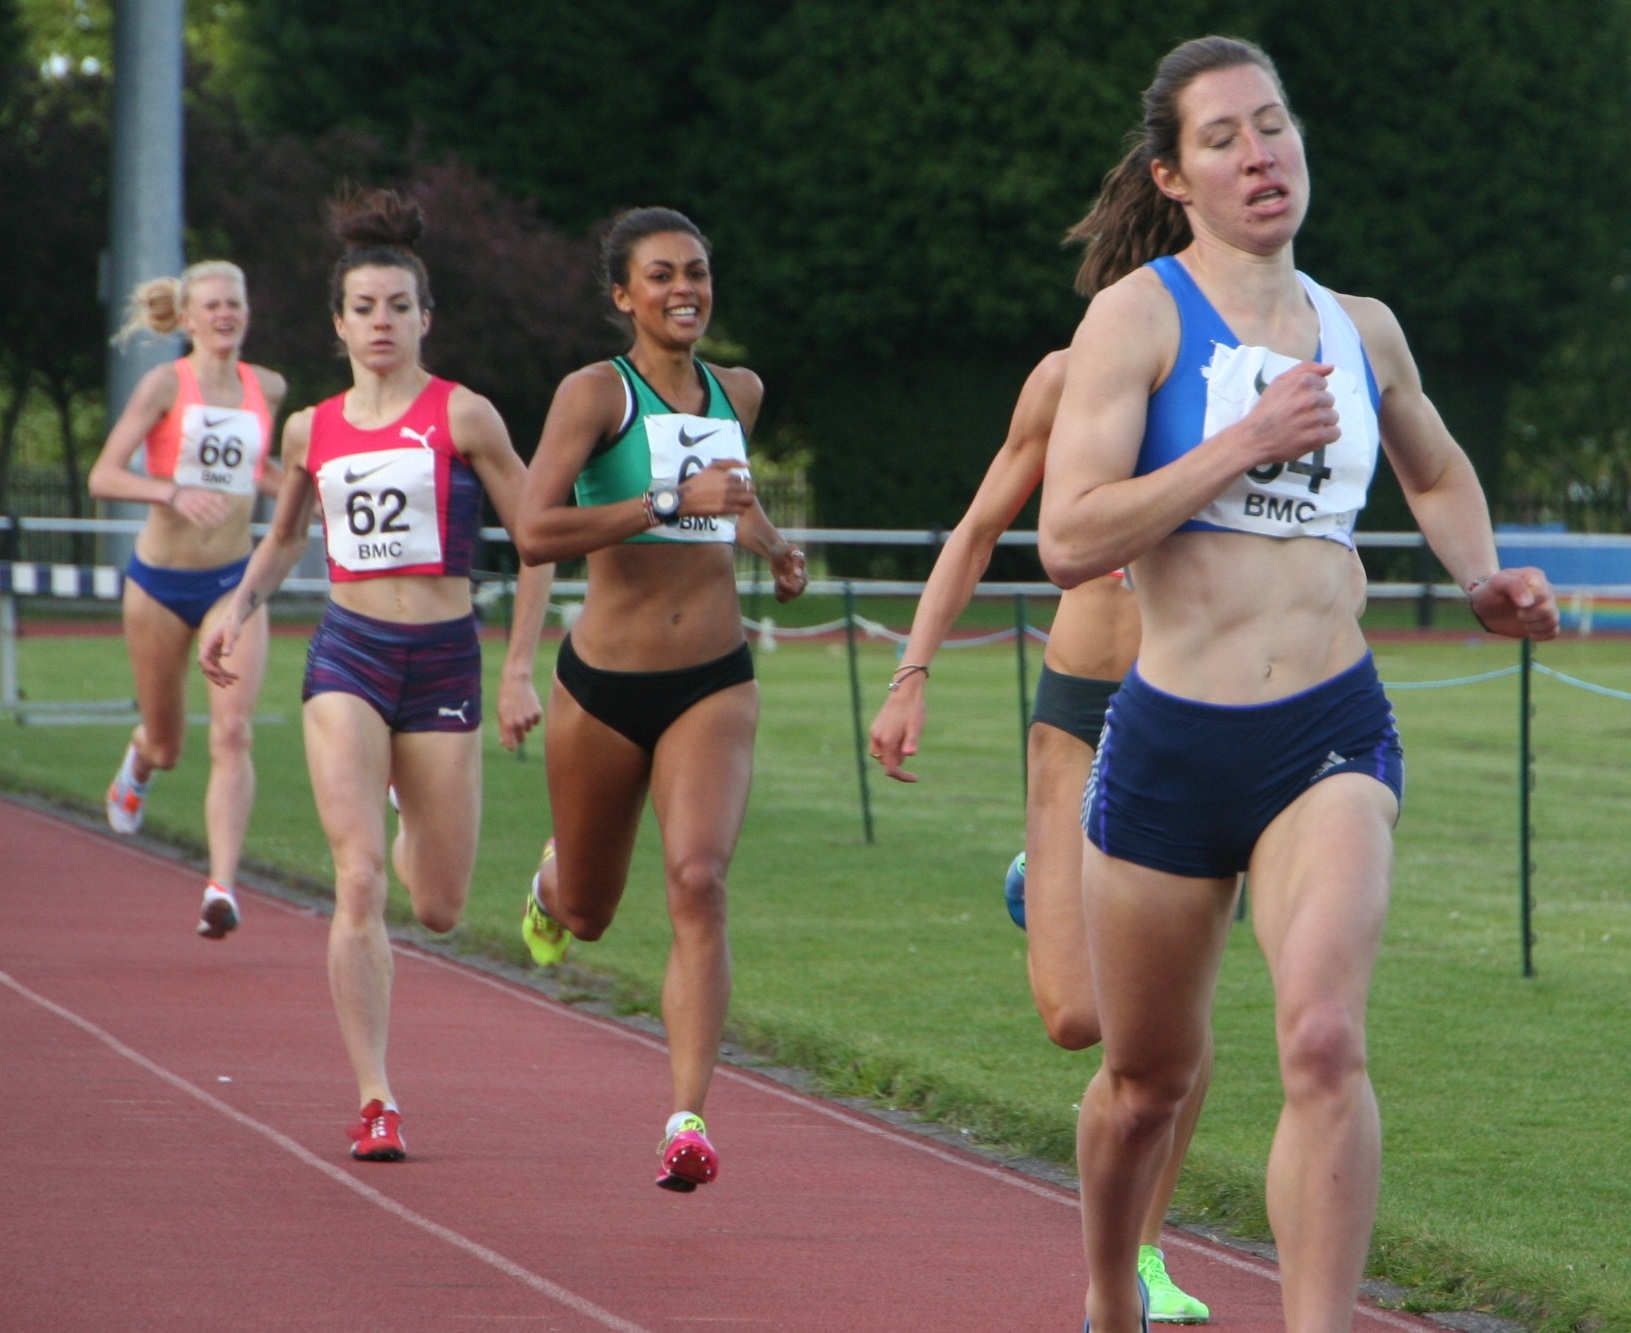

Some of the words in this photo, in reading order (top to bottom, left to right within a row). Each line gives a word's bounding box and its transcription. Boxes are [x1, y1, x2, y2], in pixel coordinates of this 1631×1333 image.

[199, 434, 243, 468] 66
[346, 488, 410, 536] 62
[1244, 493, 1317, 523] BMC
[679, 516, 718, 532] BMC
[358, 541, 402, 559] BMC
